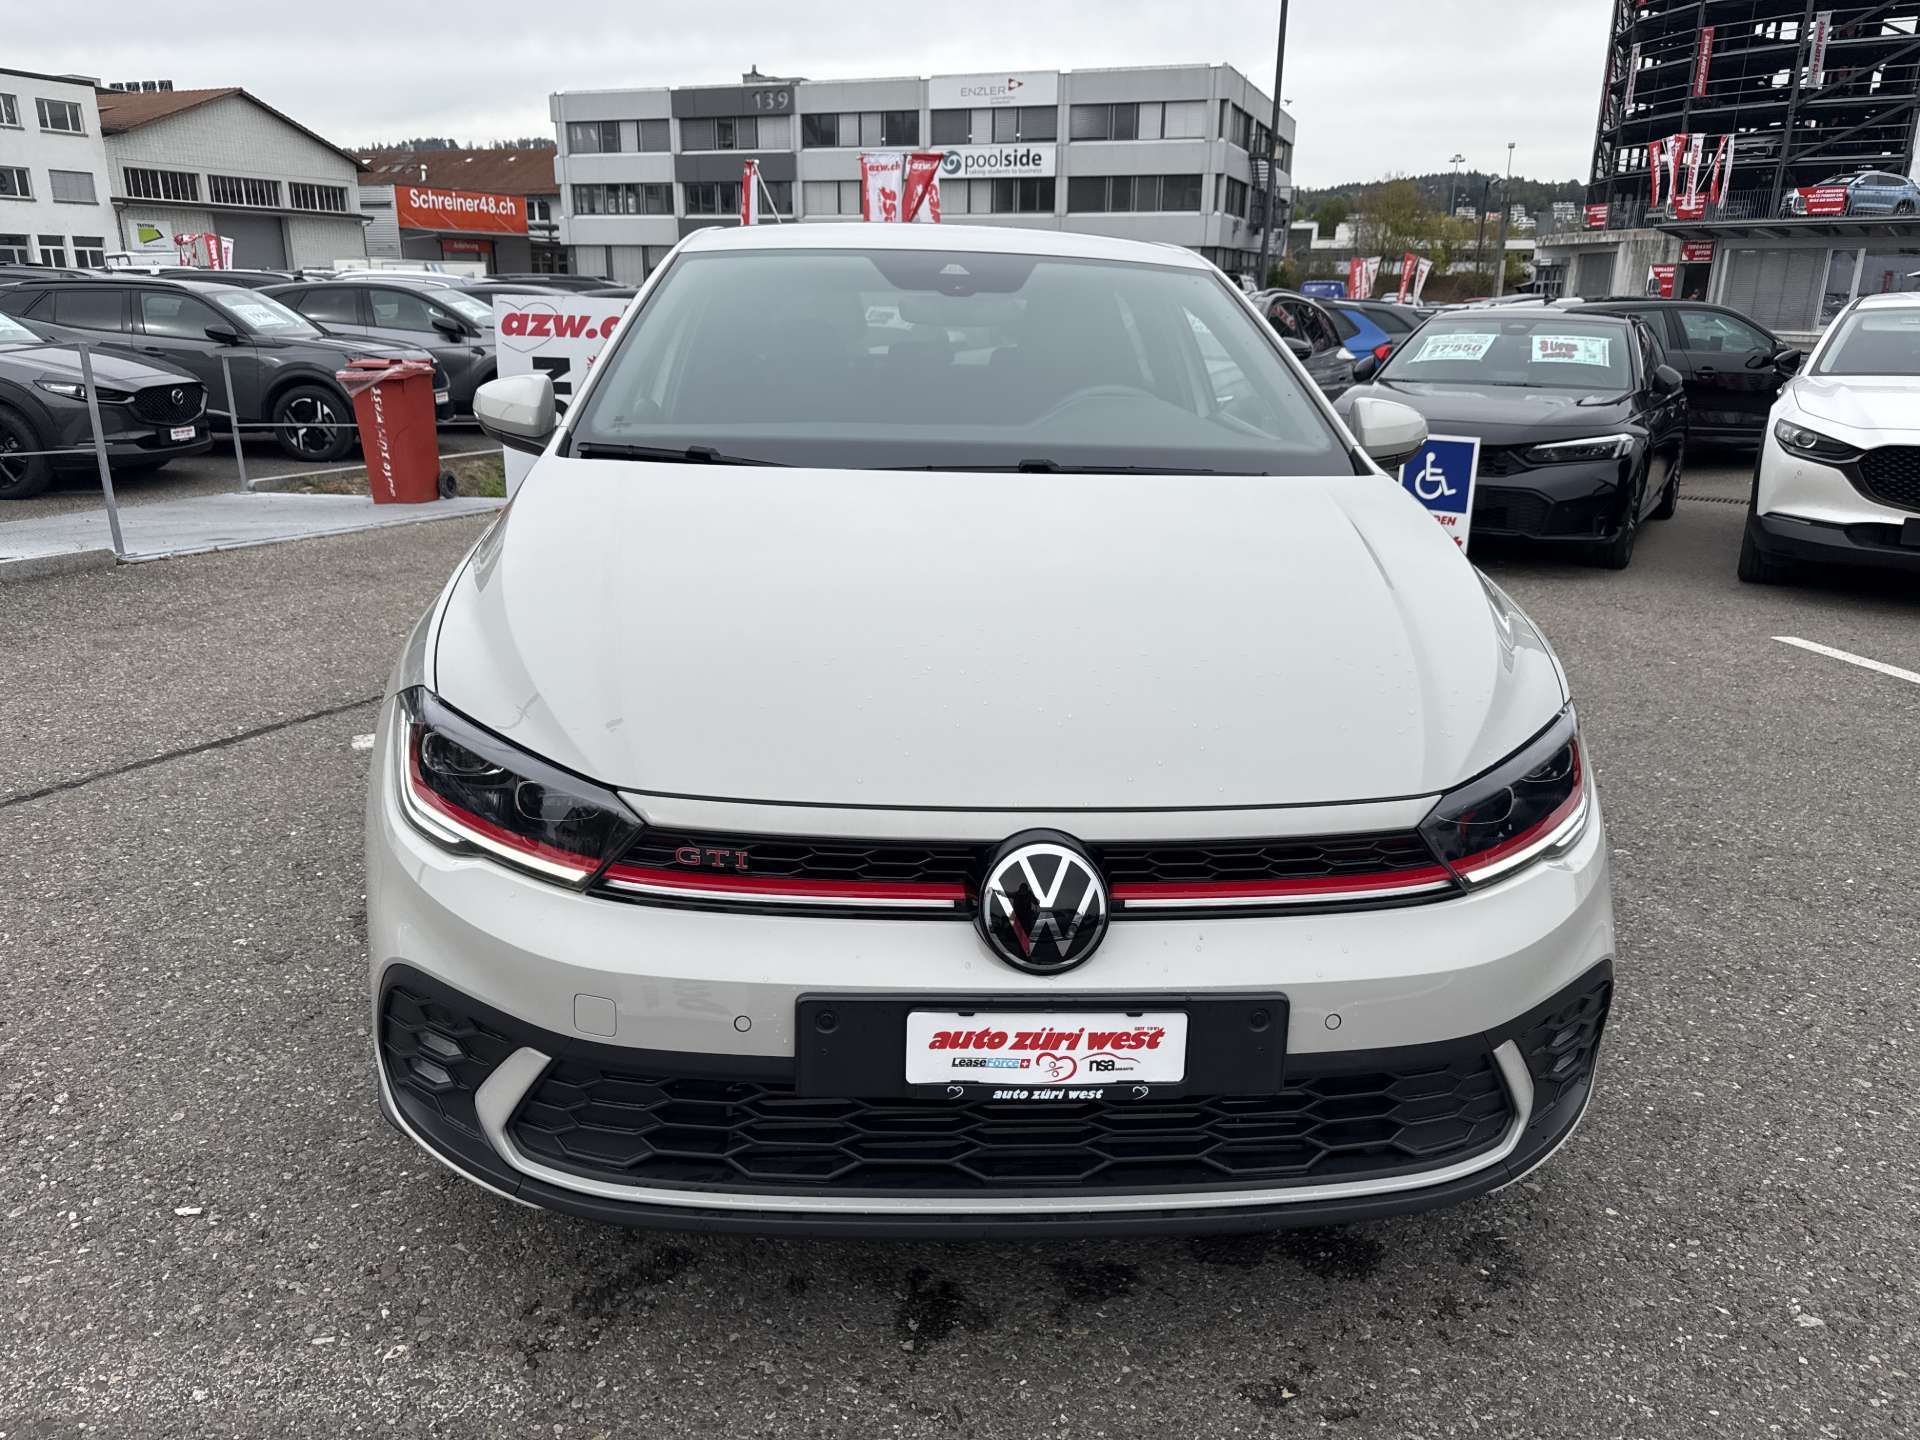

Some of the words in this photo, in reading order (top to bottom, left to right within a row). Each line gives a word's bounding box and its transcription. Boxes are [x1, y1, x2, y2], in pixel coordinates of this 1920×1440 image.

[752, 90, 789, 110] 139
[960, 86, 1006, 97] ENZLER
[869, 161, 901, 171] azw.ch
[965, 148, 1042, 175] poolside
[409, 188, 516, 215] Schreiner48.ch
[501, 306, 625, 340] azw.c
[676, 847, 748, 869] GTI
[928, 1027, 1009, 1050] auto
[1008, 1027, 1085, 1050] züri
[1087, 1027, 1166, 1050] west
[1089, 1059, 1115, 1072] nsa
[993, 1088, 1028, 1099] auto
[1031, 1088, 1064, 1099] züri
[1068, 1088, 1104, 1099] west
